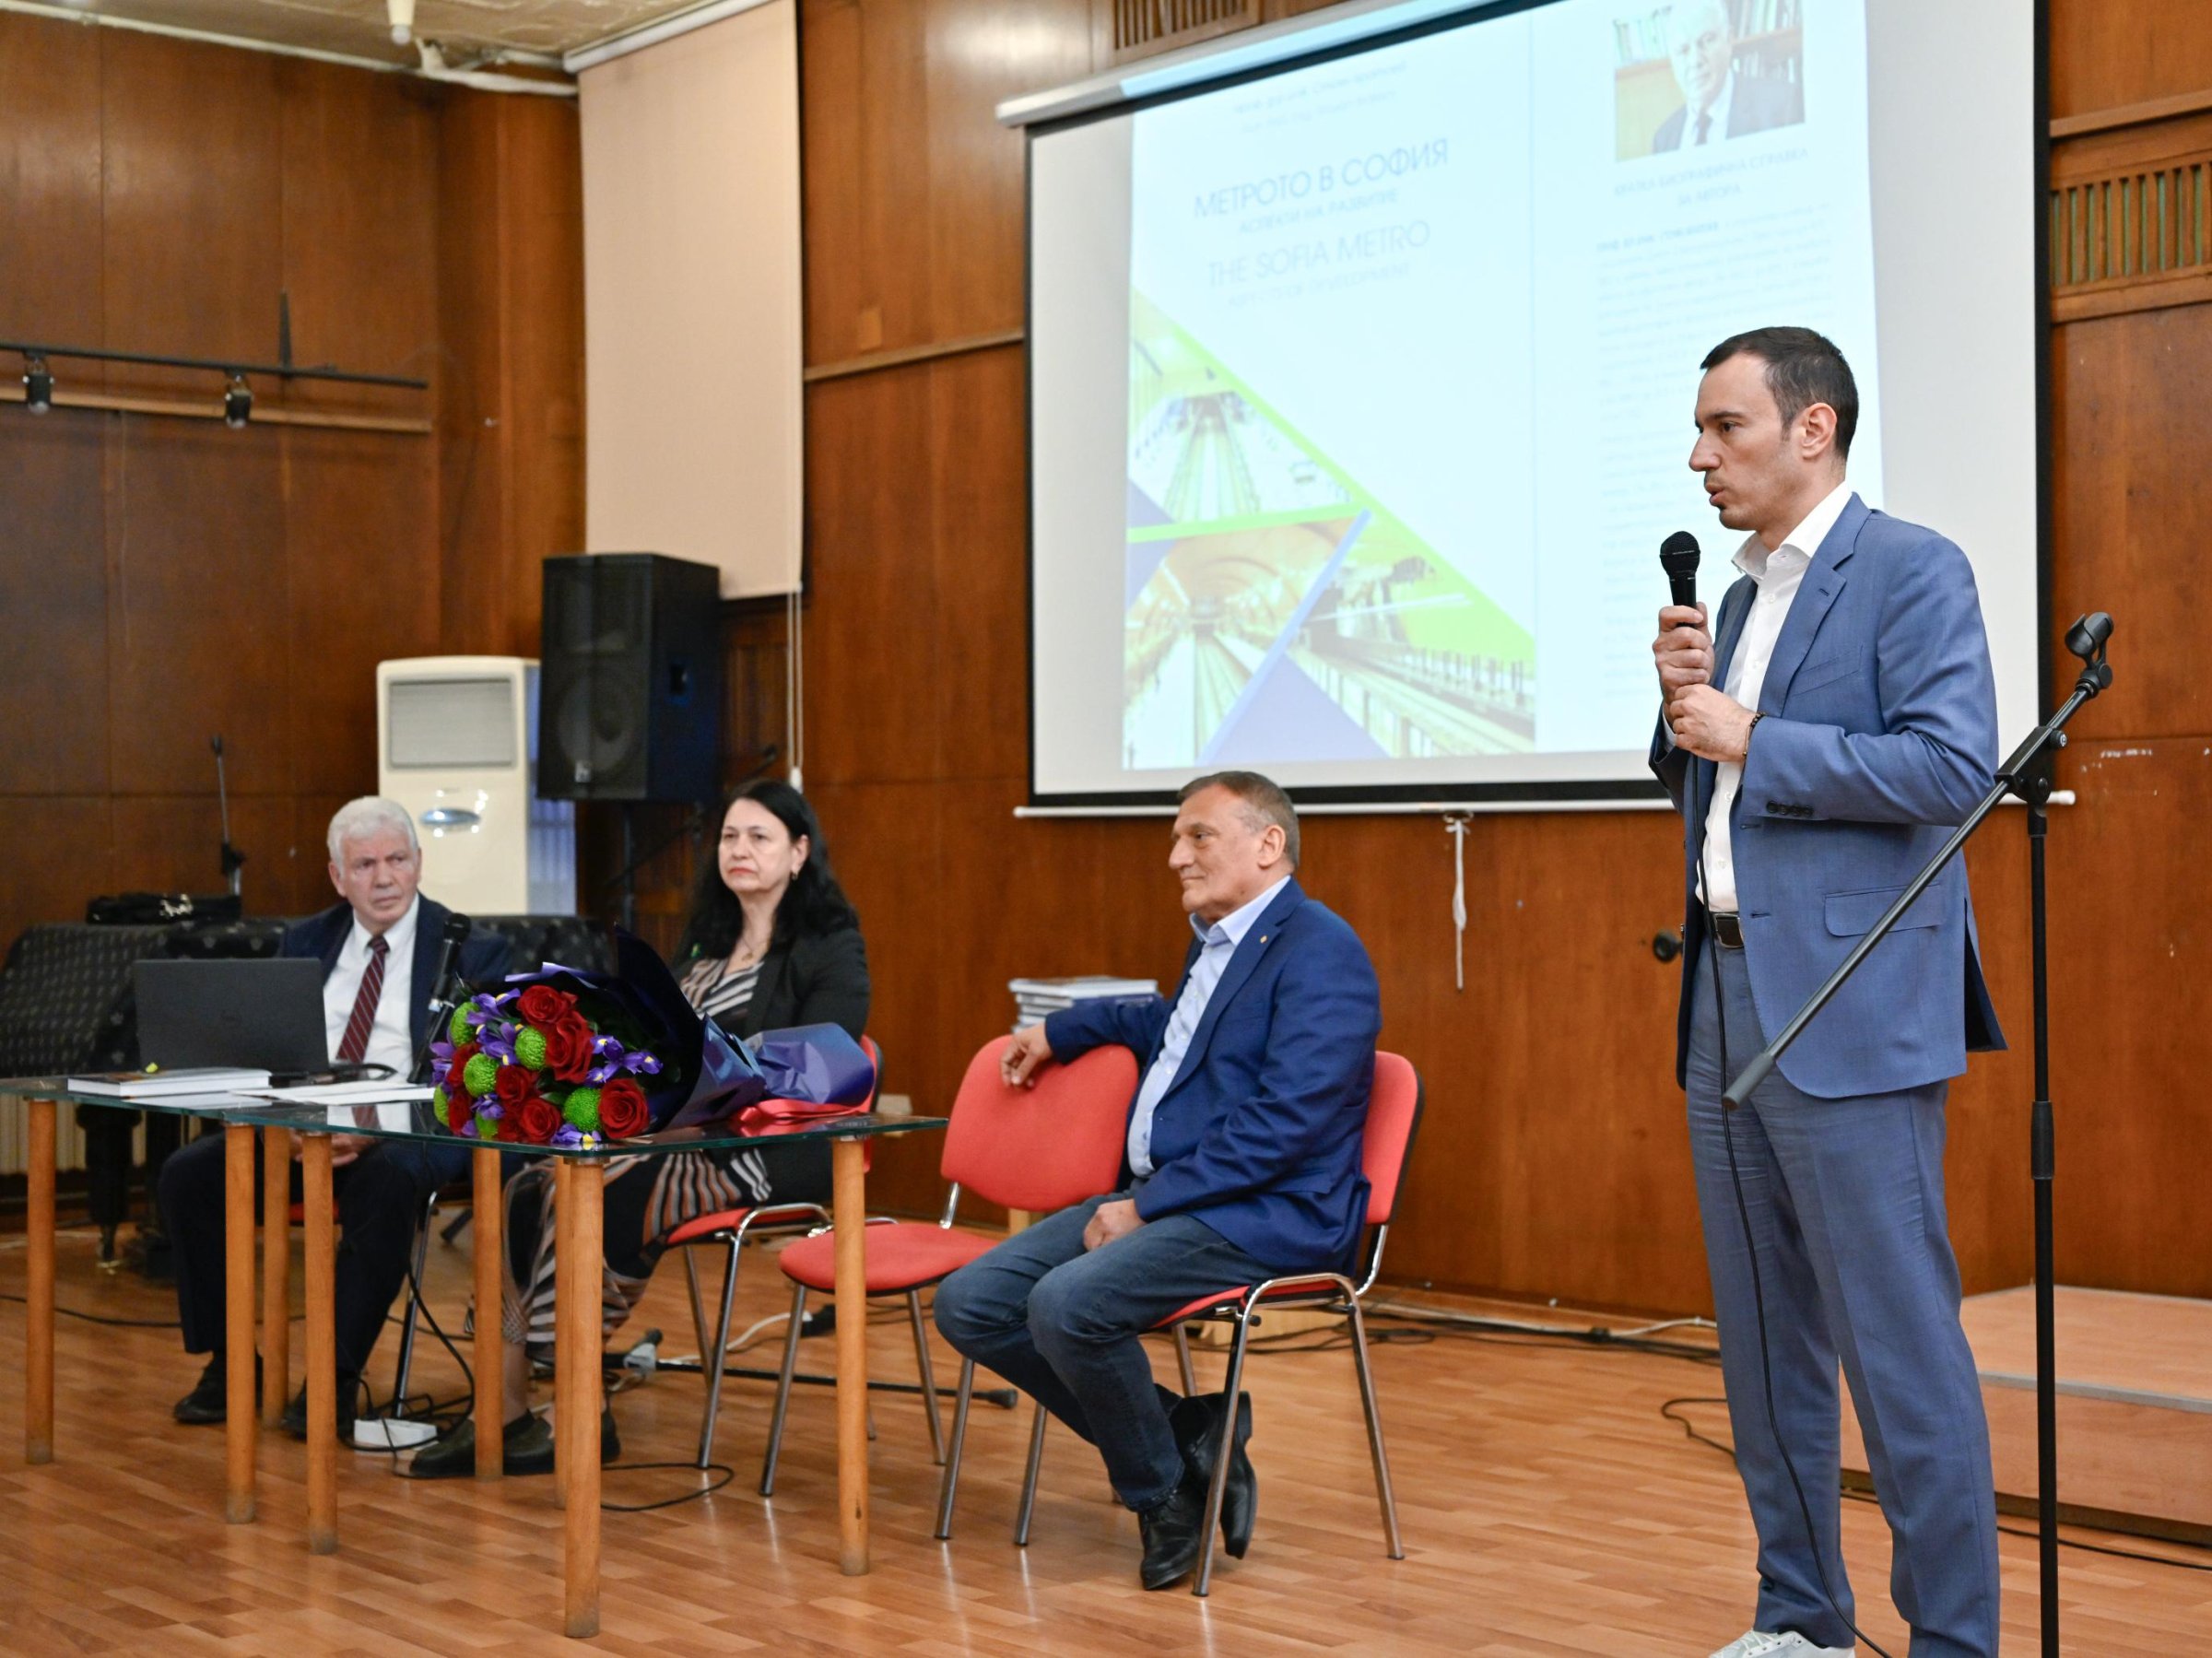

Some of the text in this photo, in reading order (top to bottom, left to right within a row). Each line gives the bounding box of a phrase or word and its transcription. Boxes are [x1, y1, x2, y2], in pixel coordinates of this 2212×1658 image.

[1193, 137, 1449, 219] МЕТРОТО В СОФИЯ
[1206, 219, 1431, 289] THE SOFIA METRO
